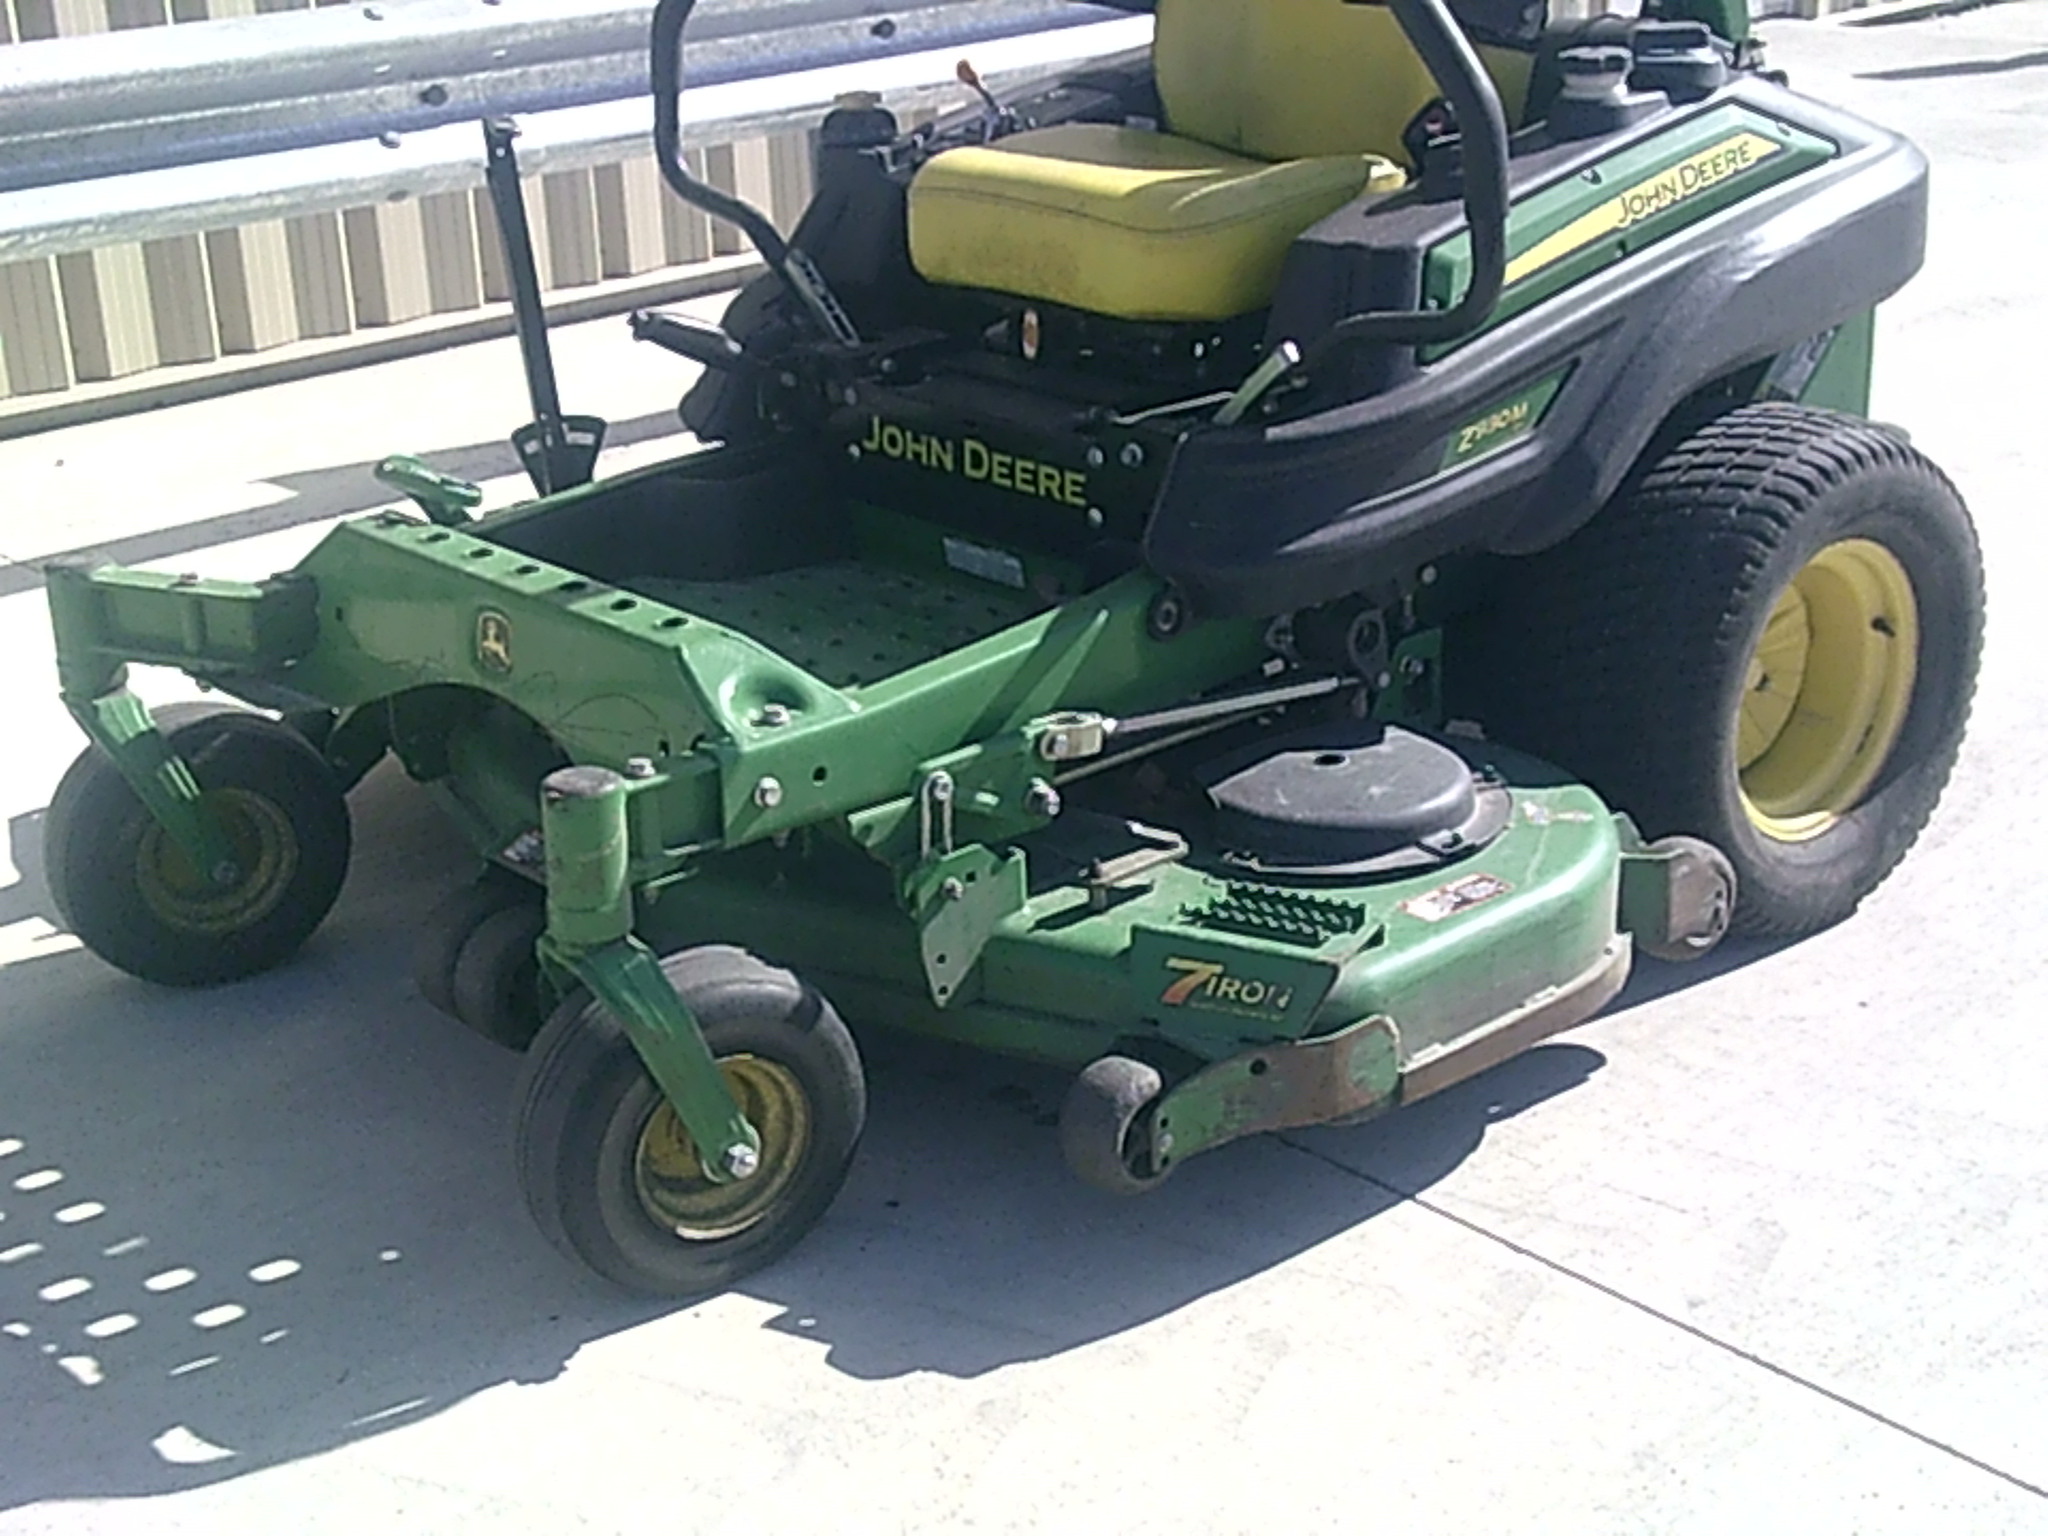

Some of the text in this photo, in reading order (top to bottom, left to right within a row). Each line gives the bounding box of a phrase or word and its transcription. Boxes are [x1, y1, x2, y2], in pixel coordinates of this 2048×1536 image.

[1618, 140, 1751, 224] JOHN DEERE
[862, 415, 1087, 505] JOHN DEERE
